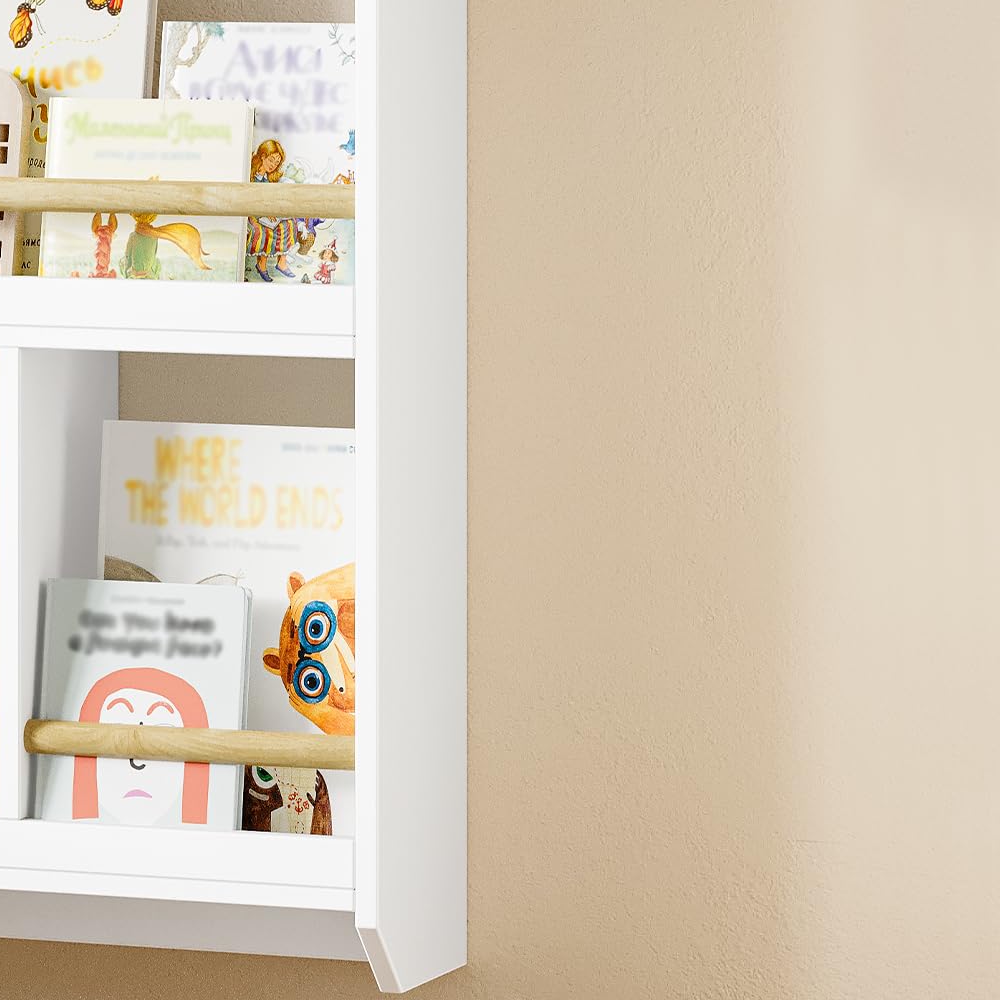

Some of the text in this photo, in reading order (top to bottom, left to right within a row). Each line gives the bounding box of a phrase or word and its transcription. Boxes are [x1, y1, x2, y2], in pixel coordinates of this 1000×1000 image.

[154, 436, 242, 484] WHERE
[124, 479, 345, 532] THE WORLD ENDS
